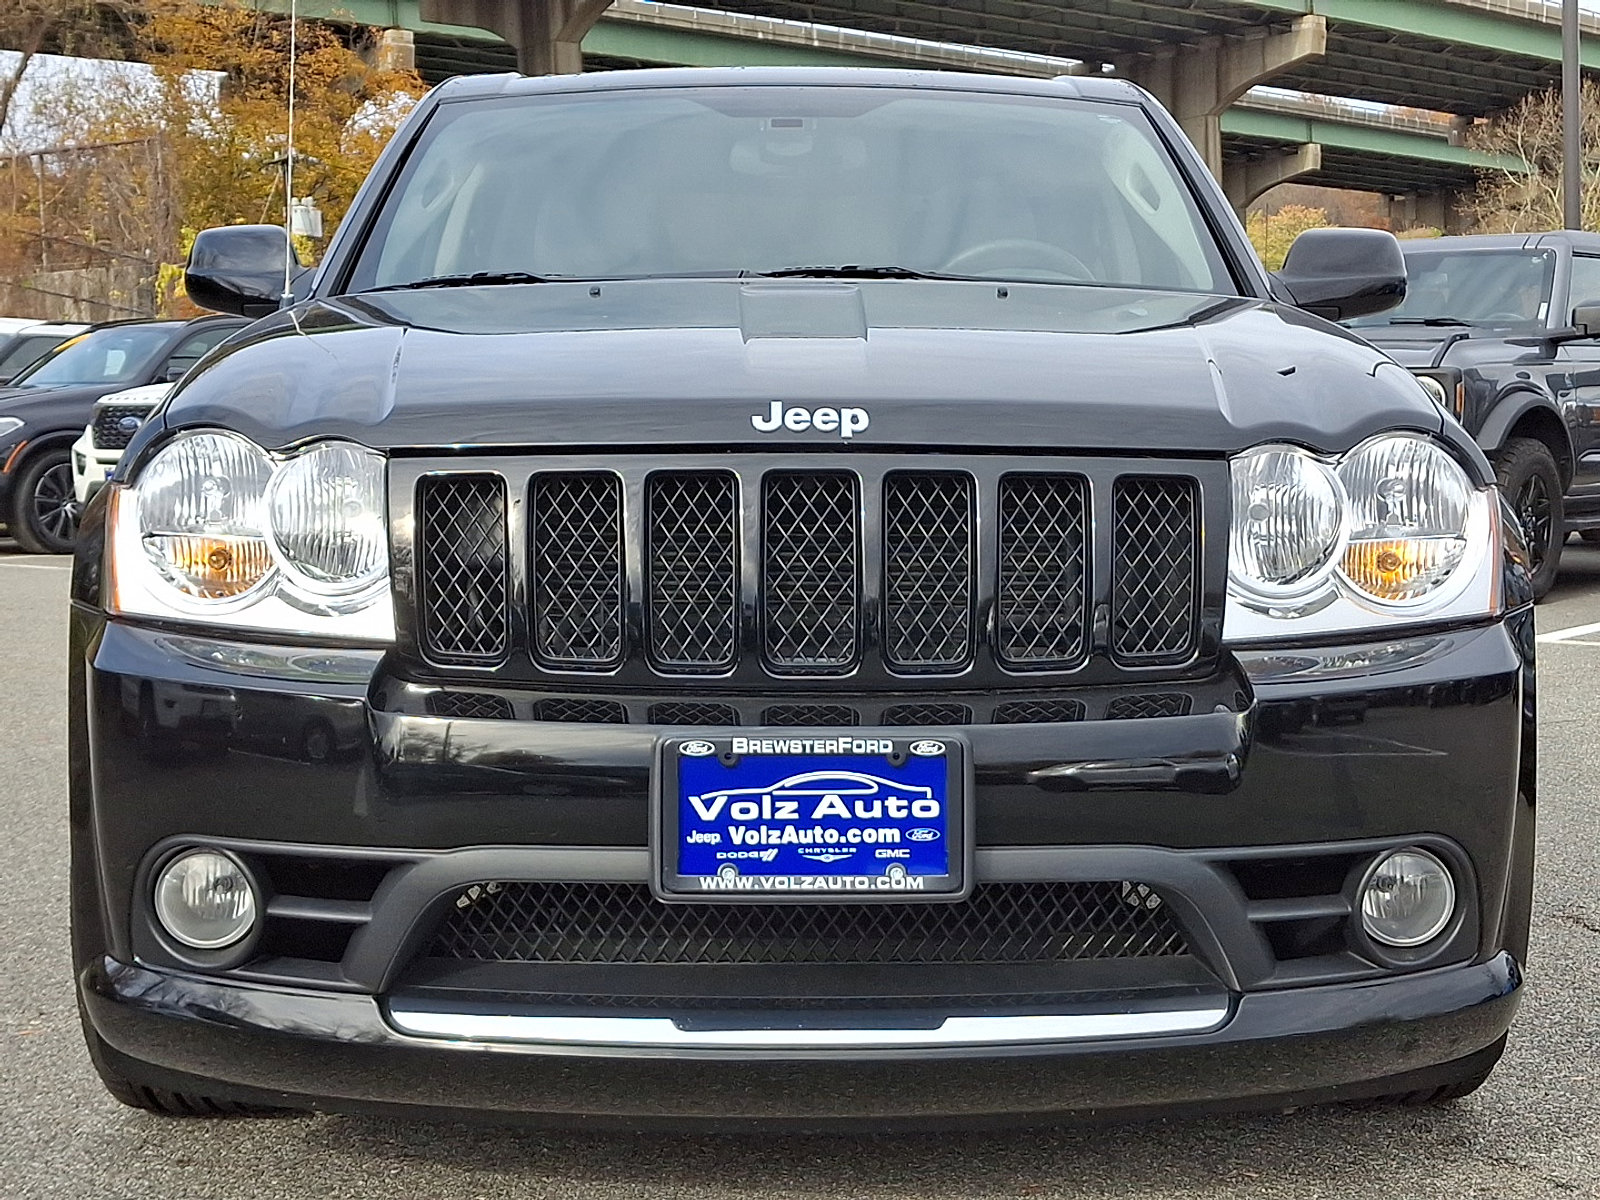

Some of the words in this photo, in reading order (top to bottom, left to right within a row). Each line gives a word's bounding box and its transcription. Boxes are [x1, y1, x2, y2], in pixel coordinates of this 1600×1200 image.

[751, 400, 869, 438] Jeep
[684, 741, 711, 755] Ford
[732, 737, 893, 753] BREWSTERFORD
[914, 741, 941, 754] Ford
[688, 795, 800, 821] Volz
[811, 794, 940, 819] Auto
[686, 829, 721, 845] Jeep
[727, 825, 901, 845] VolzAuto.com
[909, 829, 936, 840] Ford
[875, 849, 911, 858] GMC
[699, 876, 924, 889] WWW.VOLZAUTO.COM
